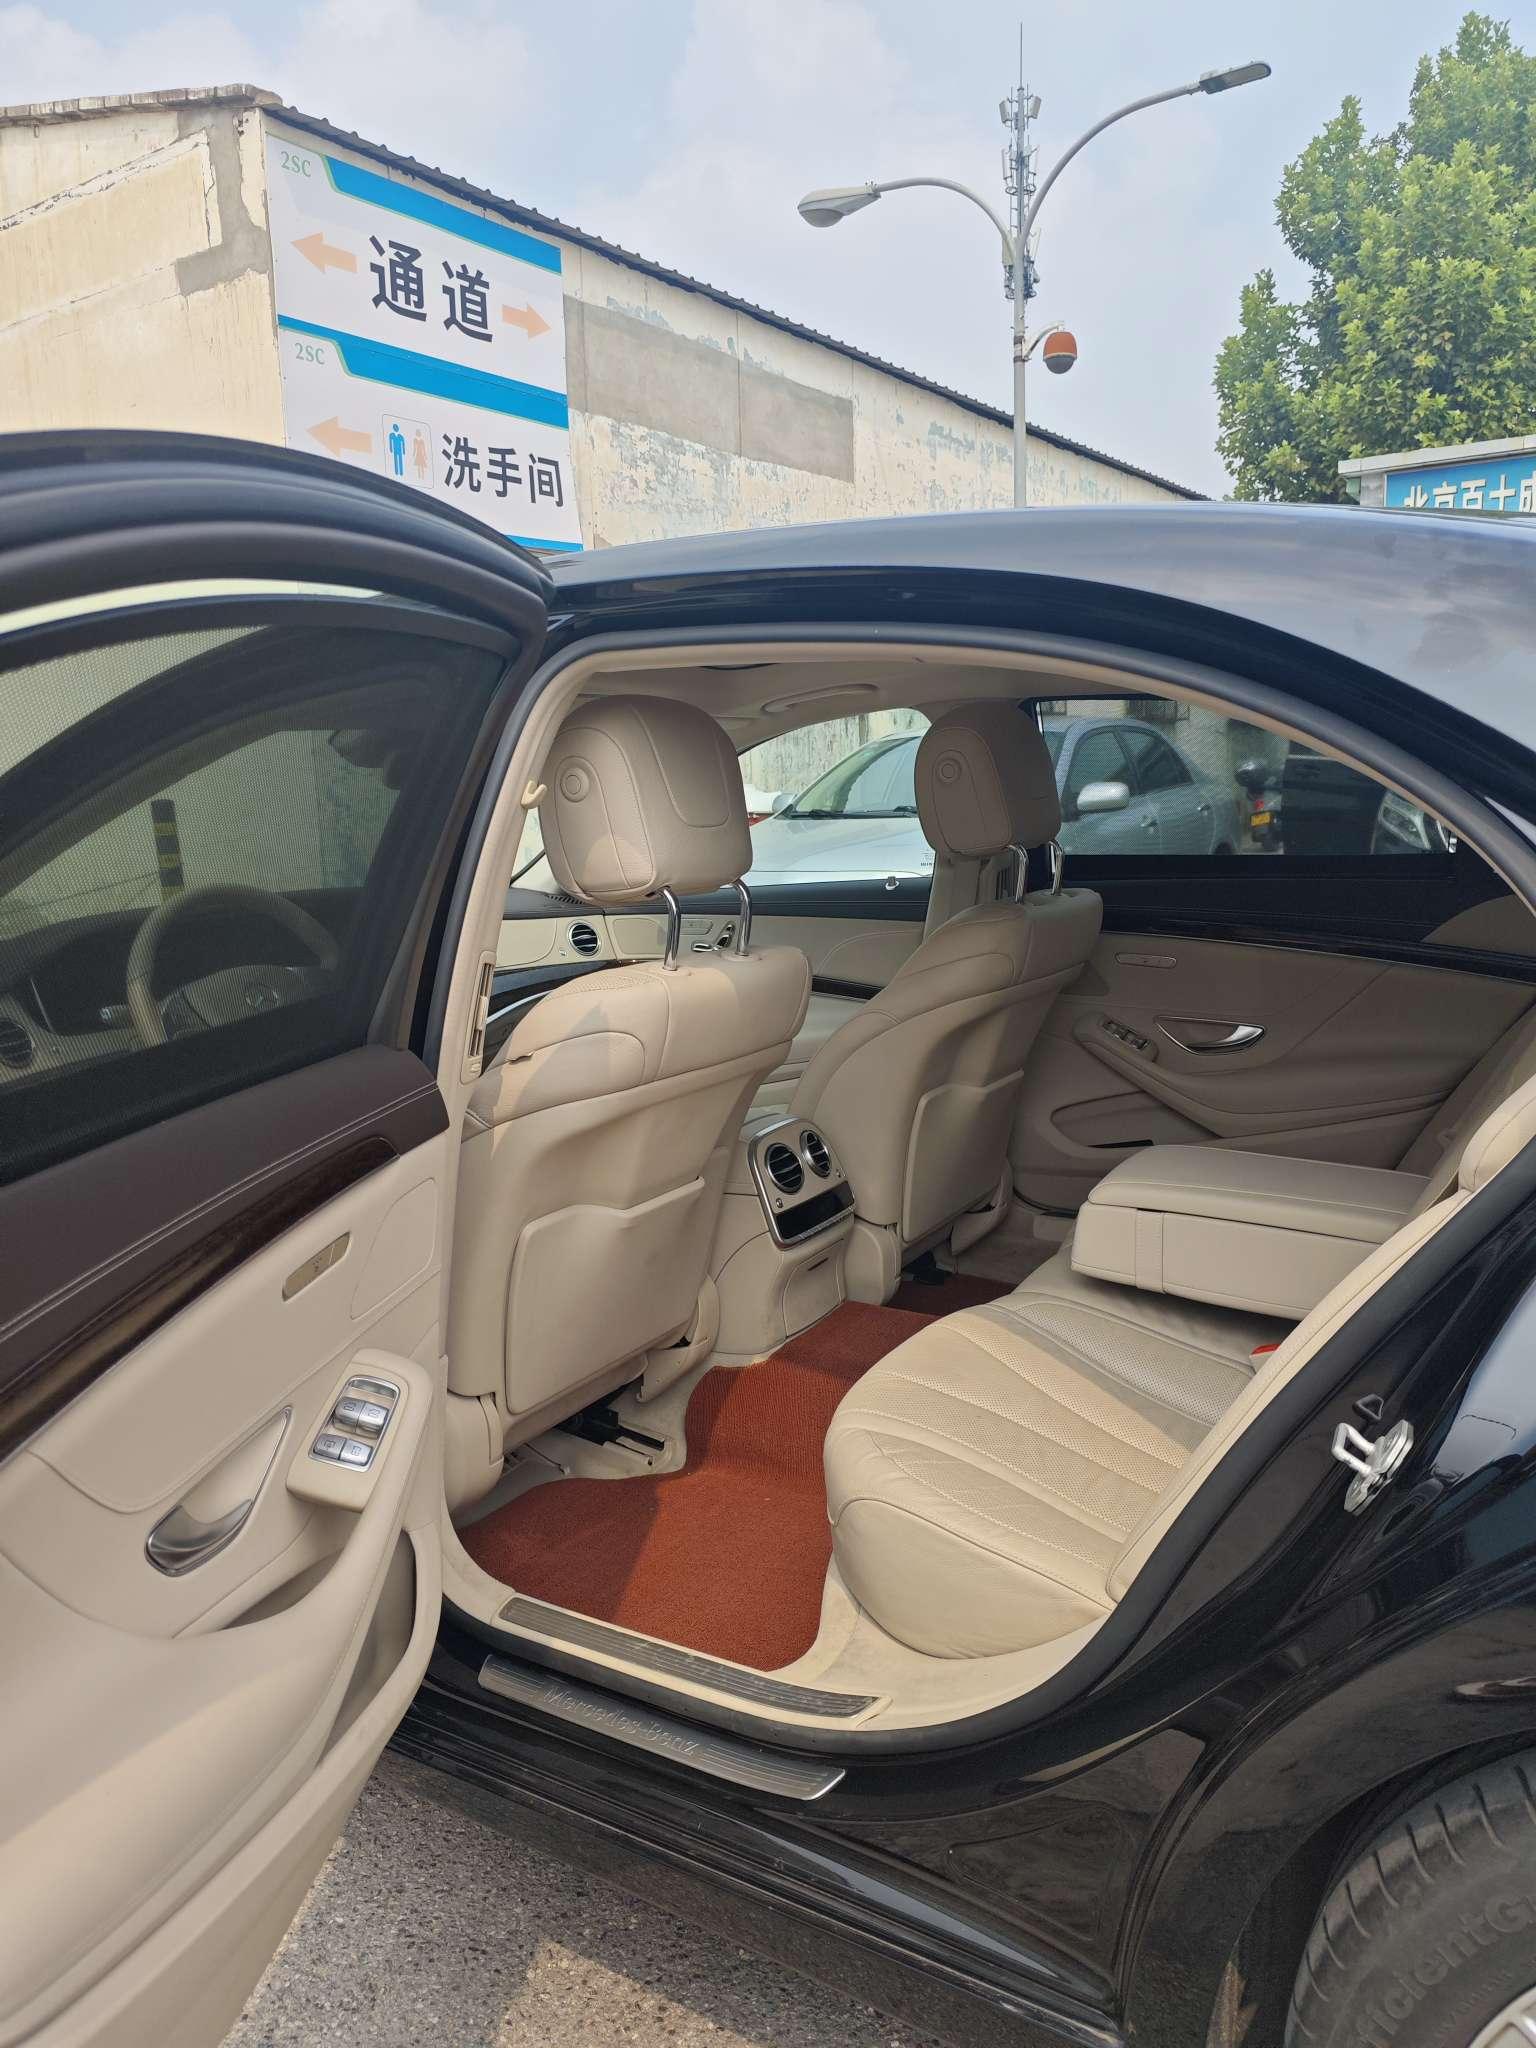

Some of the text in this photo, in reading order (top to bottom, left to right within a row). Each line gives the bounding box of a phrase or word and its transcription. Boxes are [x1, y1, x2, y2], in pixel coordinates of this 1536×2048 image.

[280, 151, 312, 178] 2SC
[369, 235, 493, 343] 通道
[294, 342, 326, 366] 2SC
[441, 433, 564, 508] 洗手间
